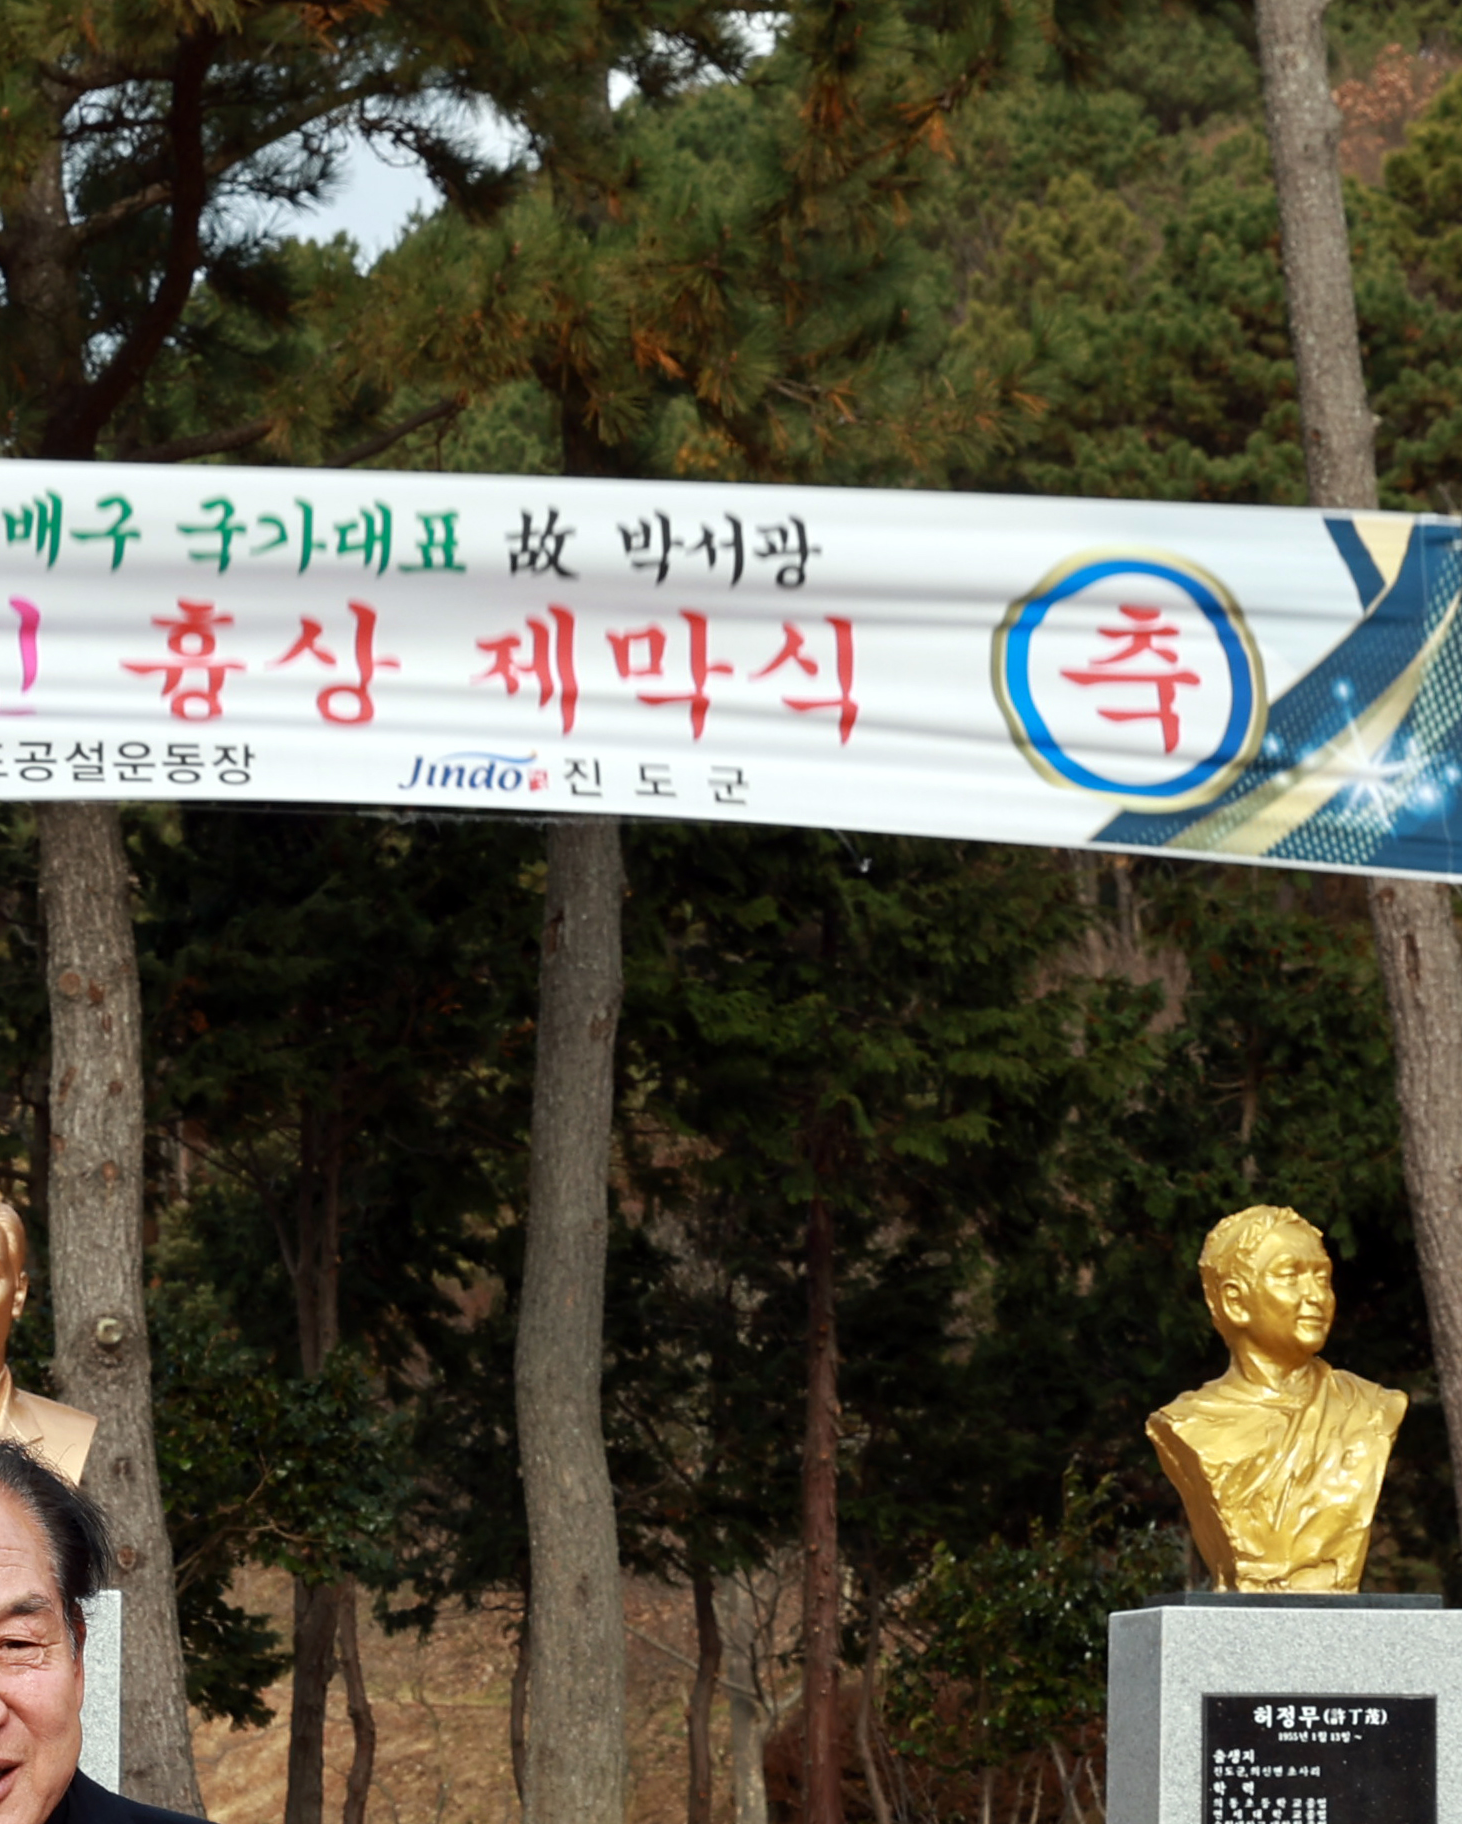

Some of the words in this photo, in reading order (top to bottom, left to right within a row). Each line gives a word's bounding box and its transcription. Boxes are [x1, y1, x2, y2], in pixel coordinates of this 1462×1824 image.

[2, 491, 141, 574] 배구
[177, 497, 468, 580] 국가대표
[508, 508, 580, 582] 故
[618, 512, 821, 593] 박서광
[124, 599, 399, 726] 흉상
[476, 601, 858, 744] 제막식
[1063, 603, 1203, 757] 축
